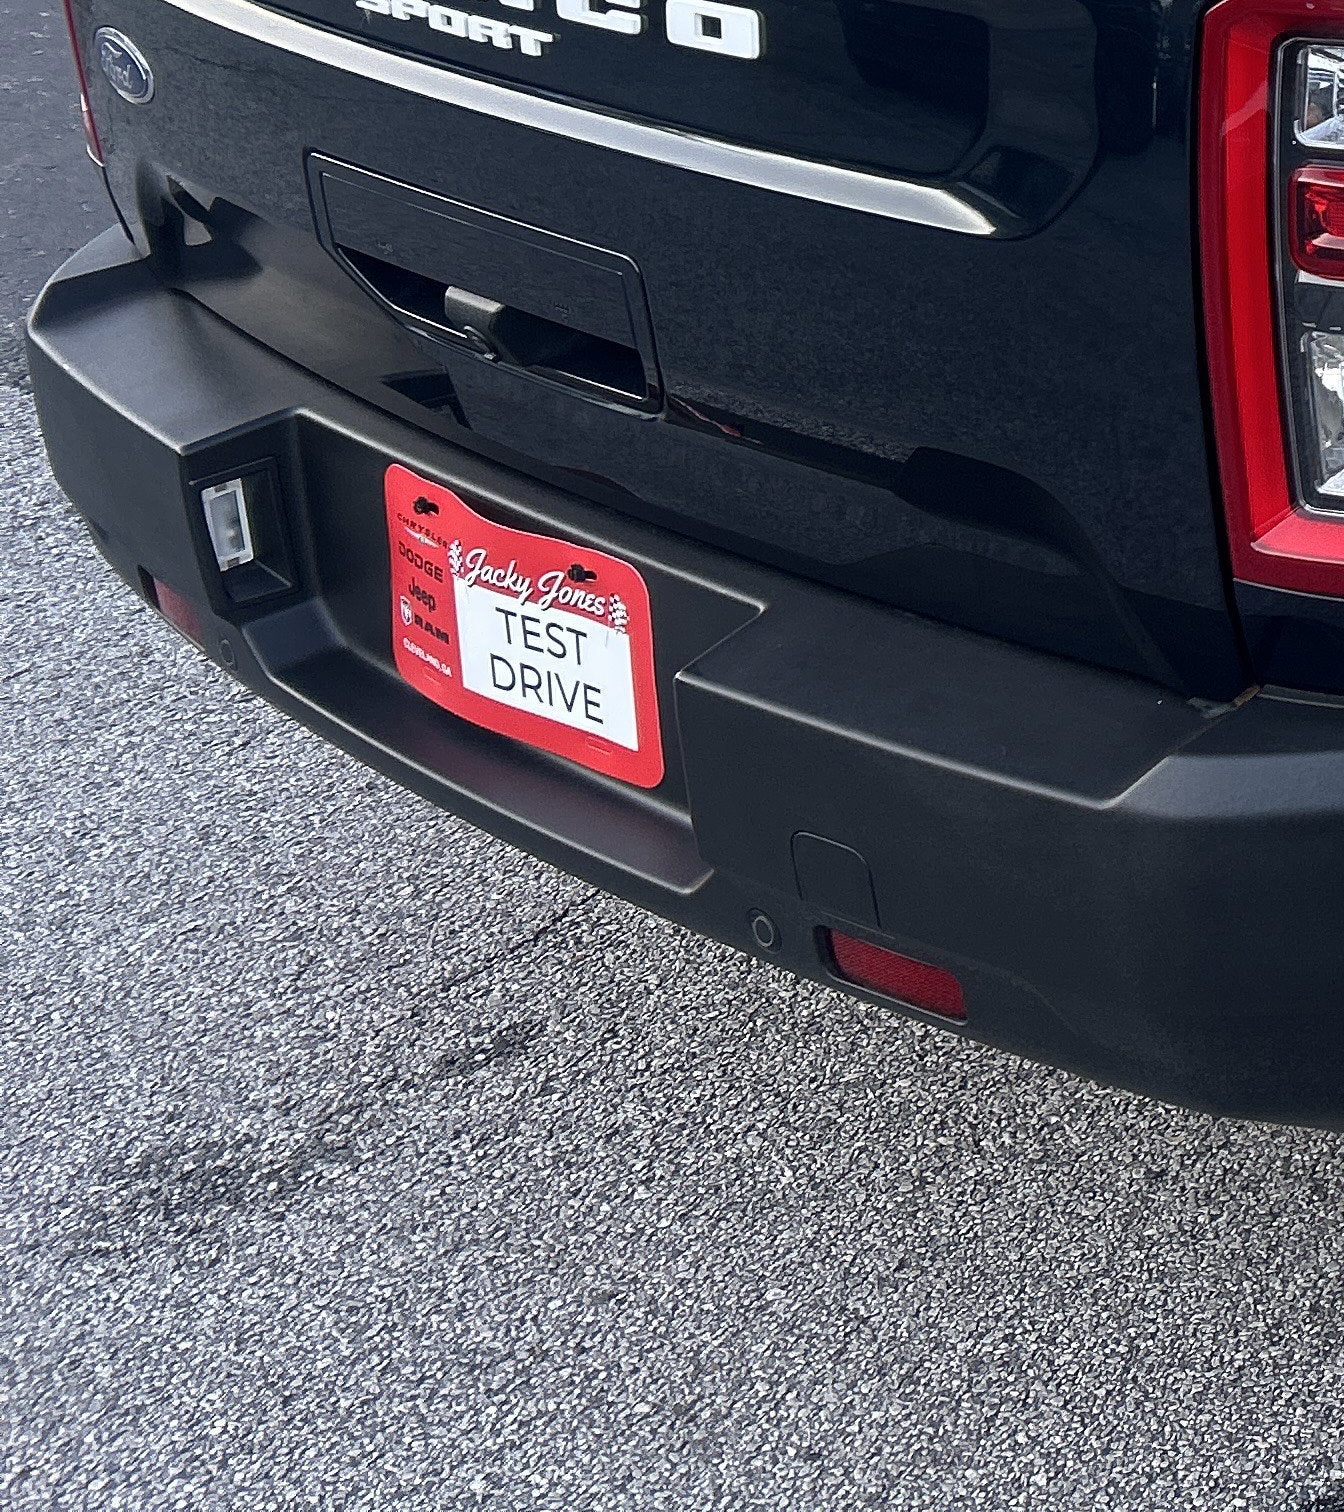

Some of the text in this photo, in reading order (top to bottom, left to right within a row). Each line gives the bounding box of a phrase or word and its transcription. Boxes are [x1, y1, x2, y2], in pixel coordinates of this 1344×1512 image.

[101, 40, 133, 90] Ford
[397, 513, 449, 549] CHRYSLER
[398, 541, 444, 583] DODGE
[465, 548, 606, 616] Jacky Jones
[408, 576, 437, 613] Jeep
[413, 614, 450, 645] RAM
[495, 606, 588, 666] TEST
[489, 653, 604, 725] DRIVE
